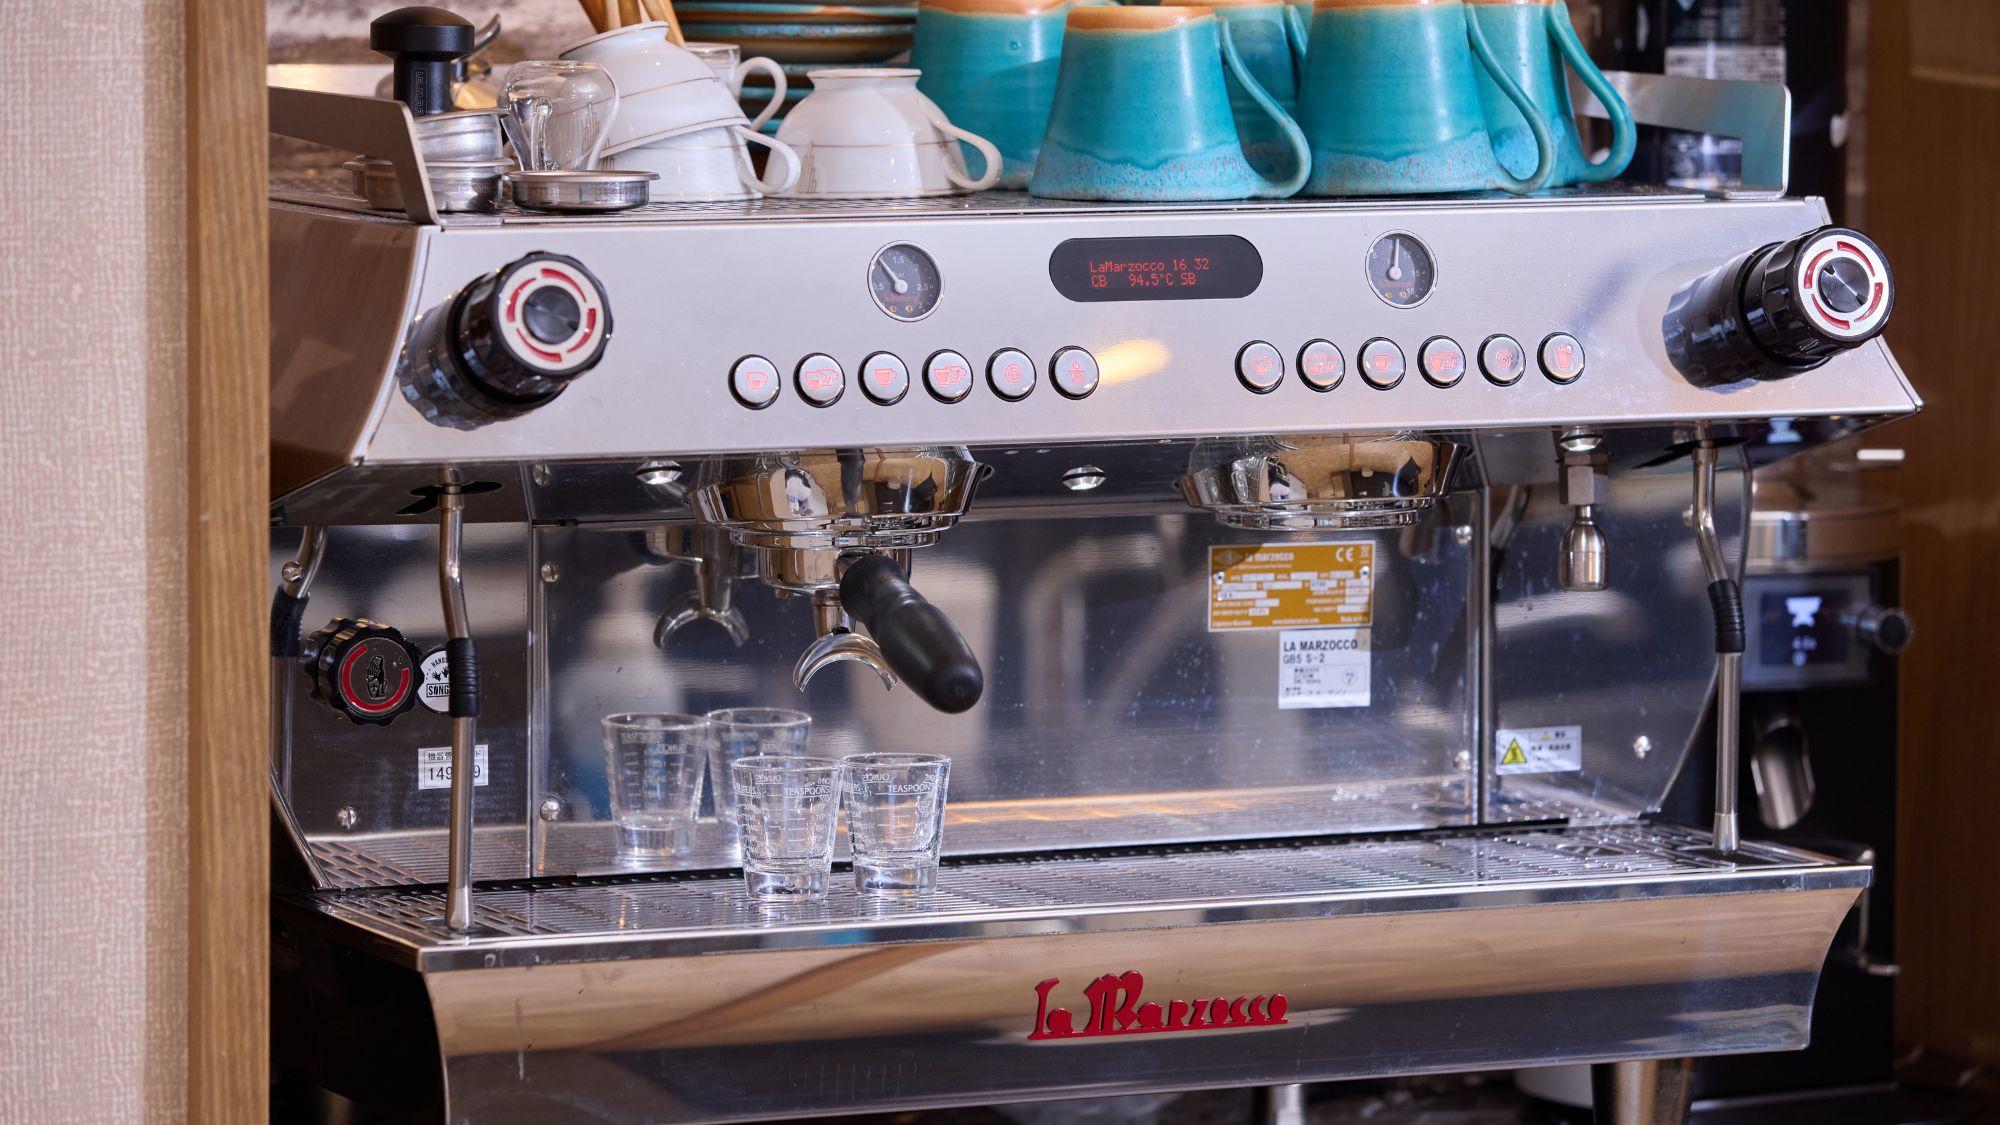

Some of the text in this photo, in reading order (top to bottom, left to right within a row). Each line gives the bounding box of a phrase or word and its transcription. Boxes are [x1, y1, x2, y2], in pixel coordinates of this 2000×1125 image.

[1090, 257, 1209, 273] LaMarzocco 16 32
[1091, 271, 1197, 288] CB 94.5°C SB
[1283, 639, 1358, 652] LA MARZOCCO
[1305, 653, 1325, 663] S-2
[429, 765, 481, 781] 1499
